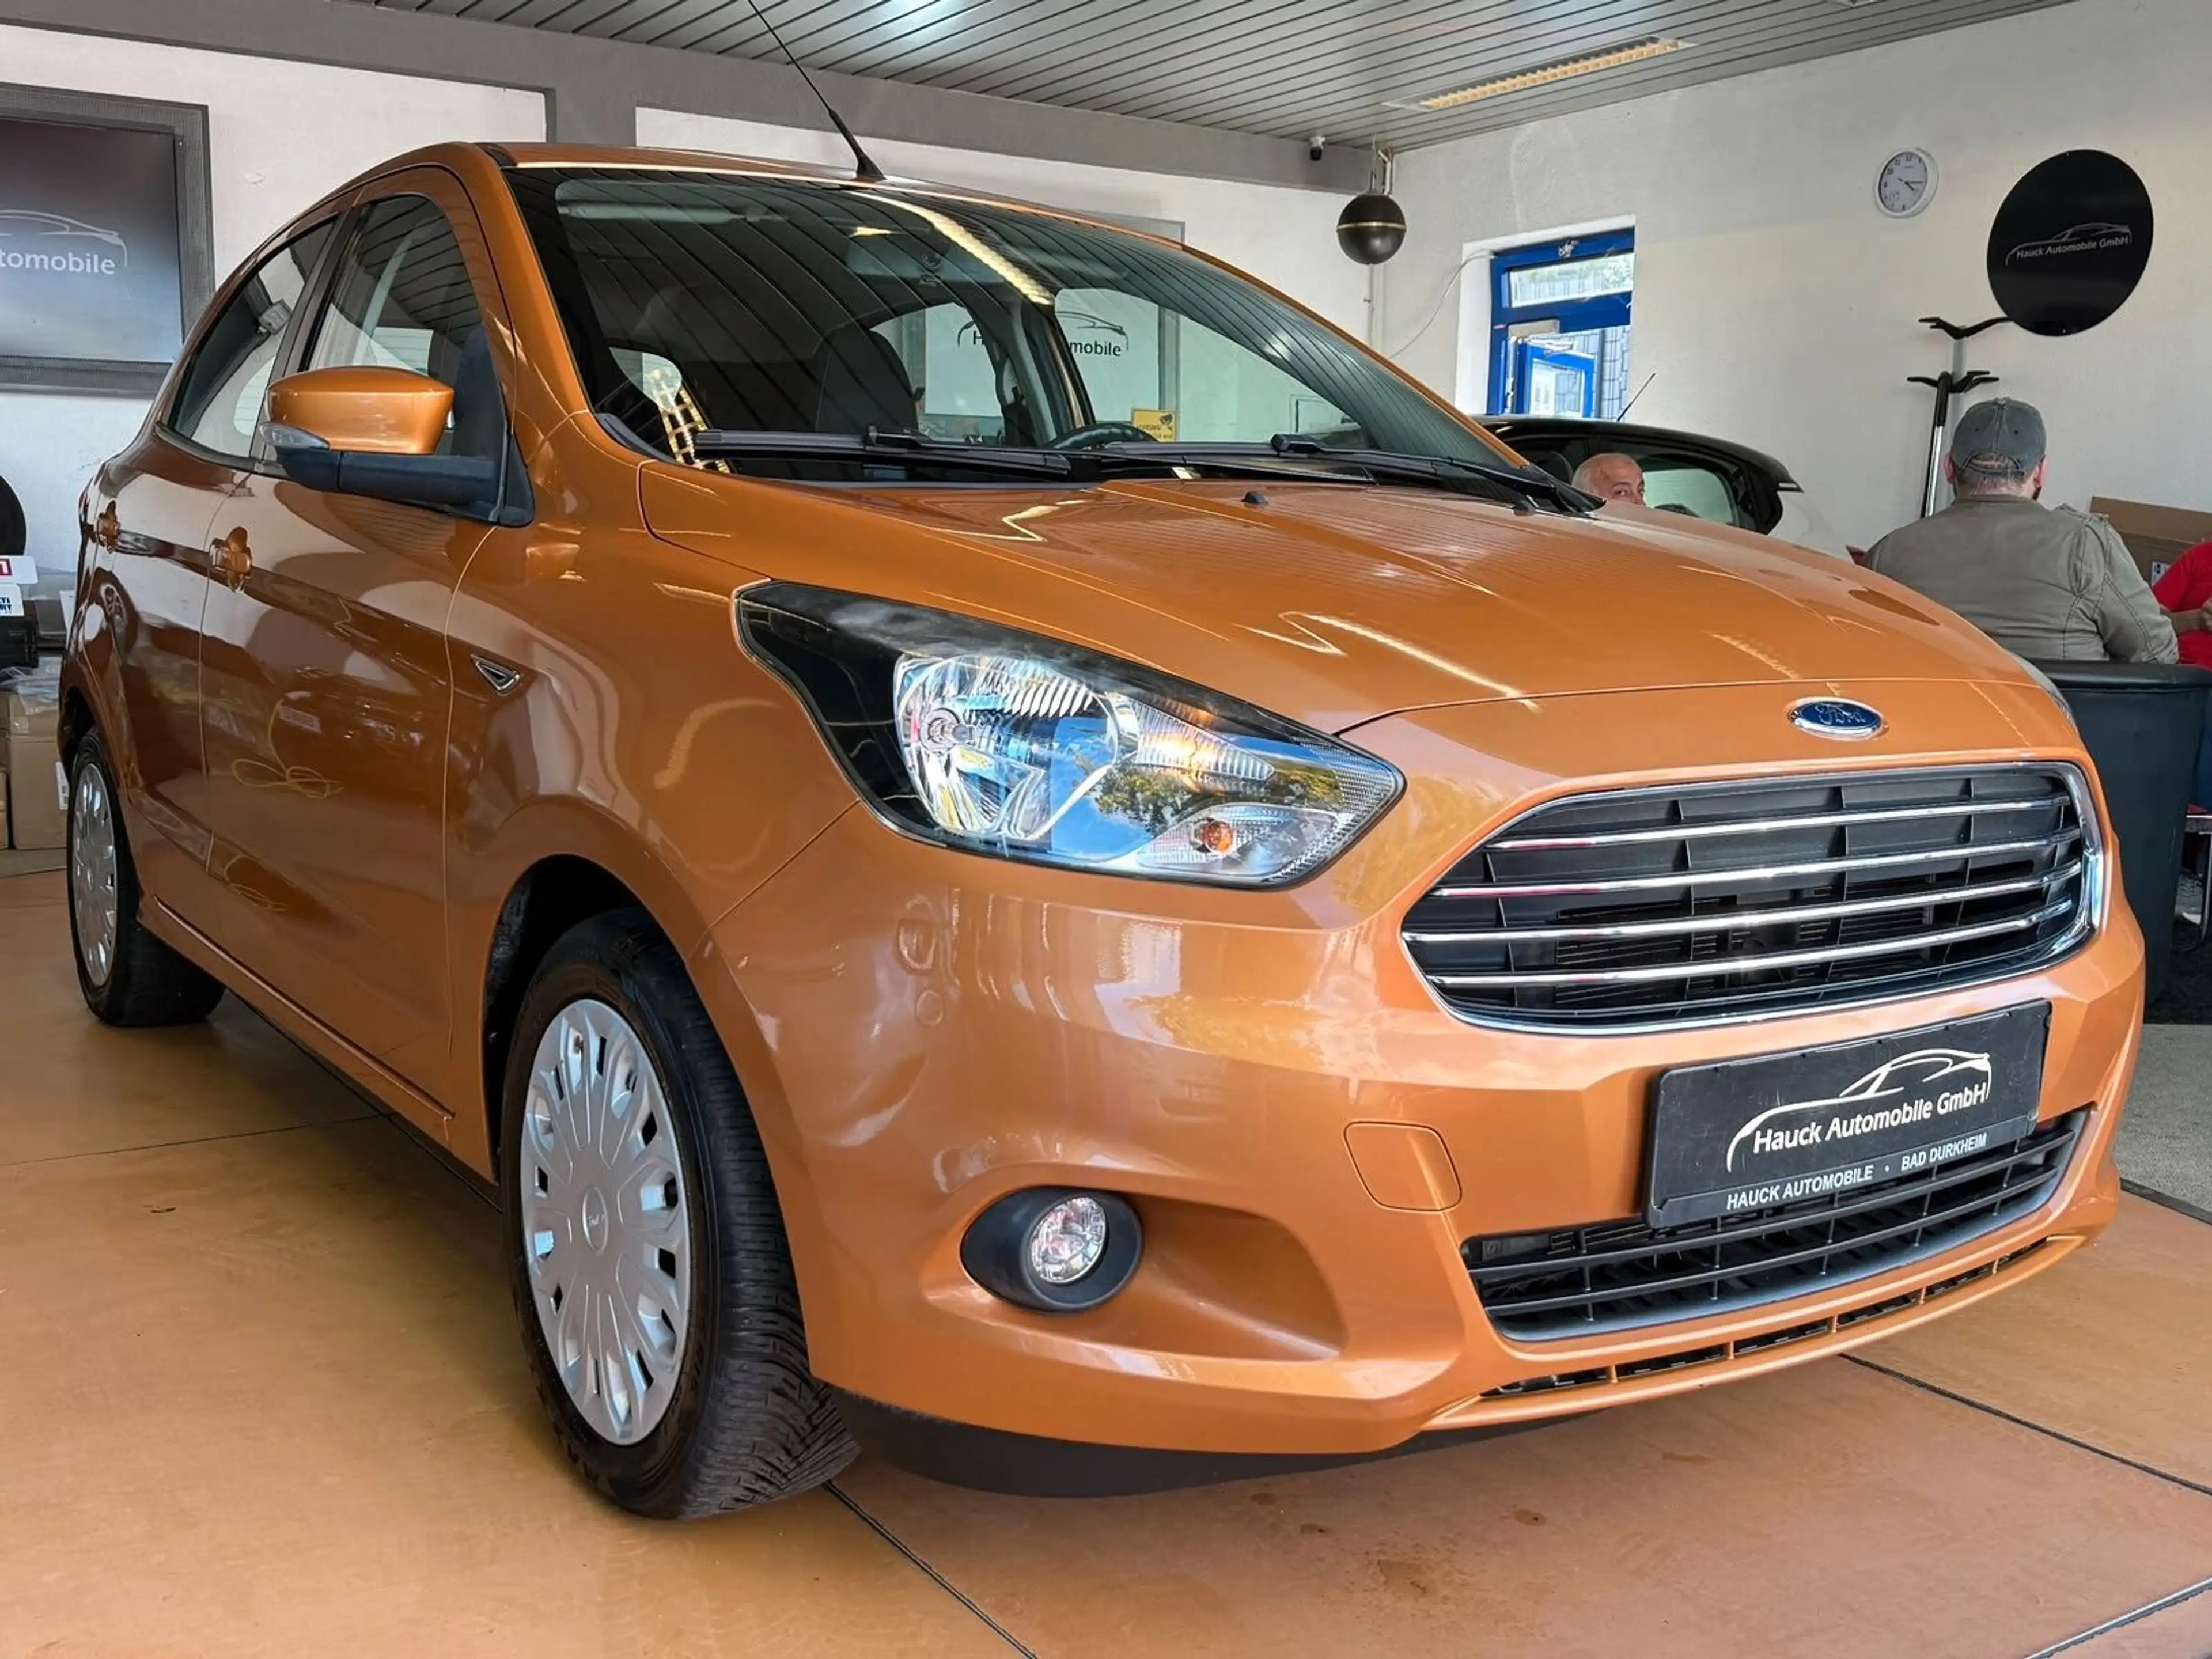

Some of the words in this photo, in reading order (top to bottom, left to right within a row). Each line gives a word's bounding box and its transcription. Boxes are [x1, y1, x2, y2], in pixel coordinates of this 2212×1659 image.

[2017, 247, 2045, 259] Hauck
[2045, 241, 2097, 255] Automobile
[2099, 236, 2129, 248] GmbH
[1753, 1121, 1822, 1154] Hauck
[1825, 1100, 1933, 1141] Automobile
[1936, 1082, 1987, 1116] GmbH
[1726, 1184, 1781, 1210] HAUCK
[1782, 1164, 1874, 1200] AUTOMOBILE
[1900, 1150, 1927, 1171] BAD
